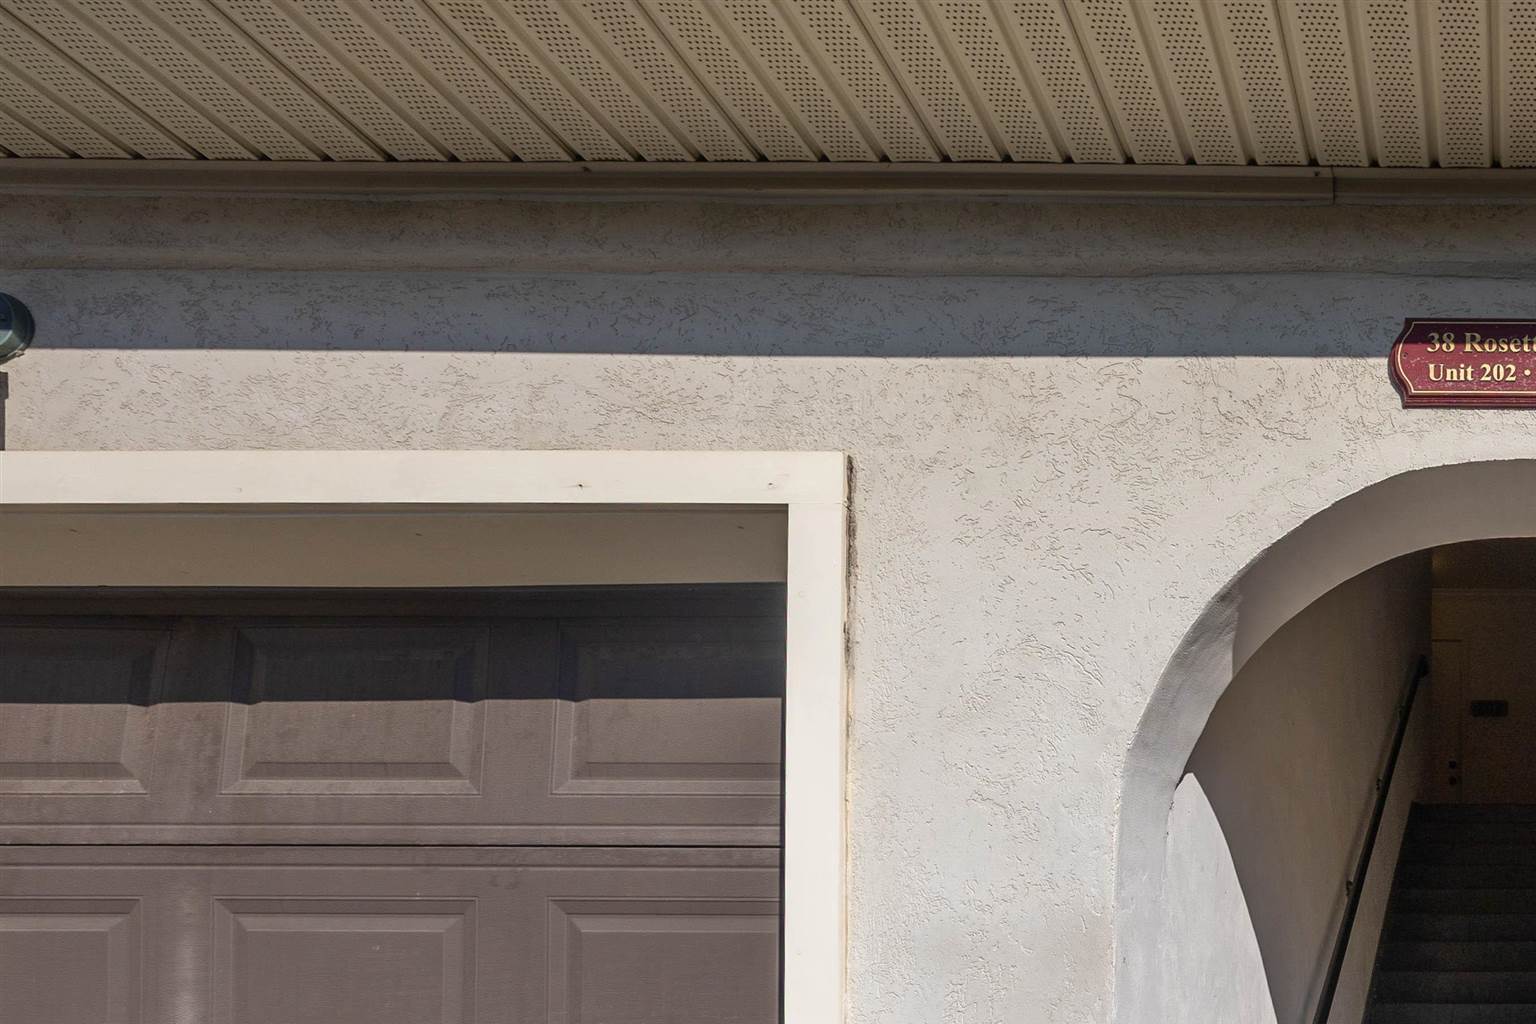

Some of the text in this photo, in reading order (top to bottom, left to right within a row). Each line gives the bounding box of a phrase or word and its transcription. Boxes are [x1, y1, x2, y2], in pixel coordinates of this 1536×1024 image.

[1427, 332, 1455, 353] 38
[1428, 363, 1474, 382] Unit
[1480, 364, 1516, 382] 202
